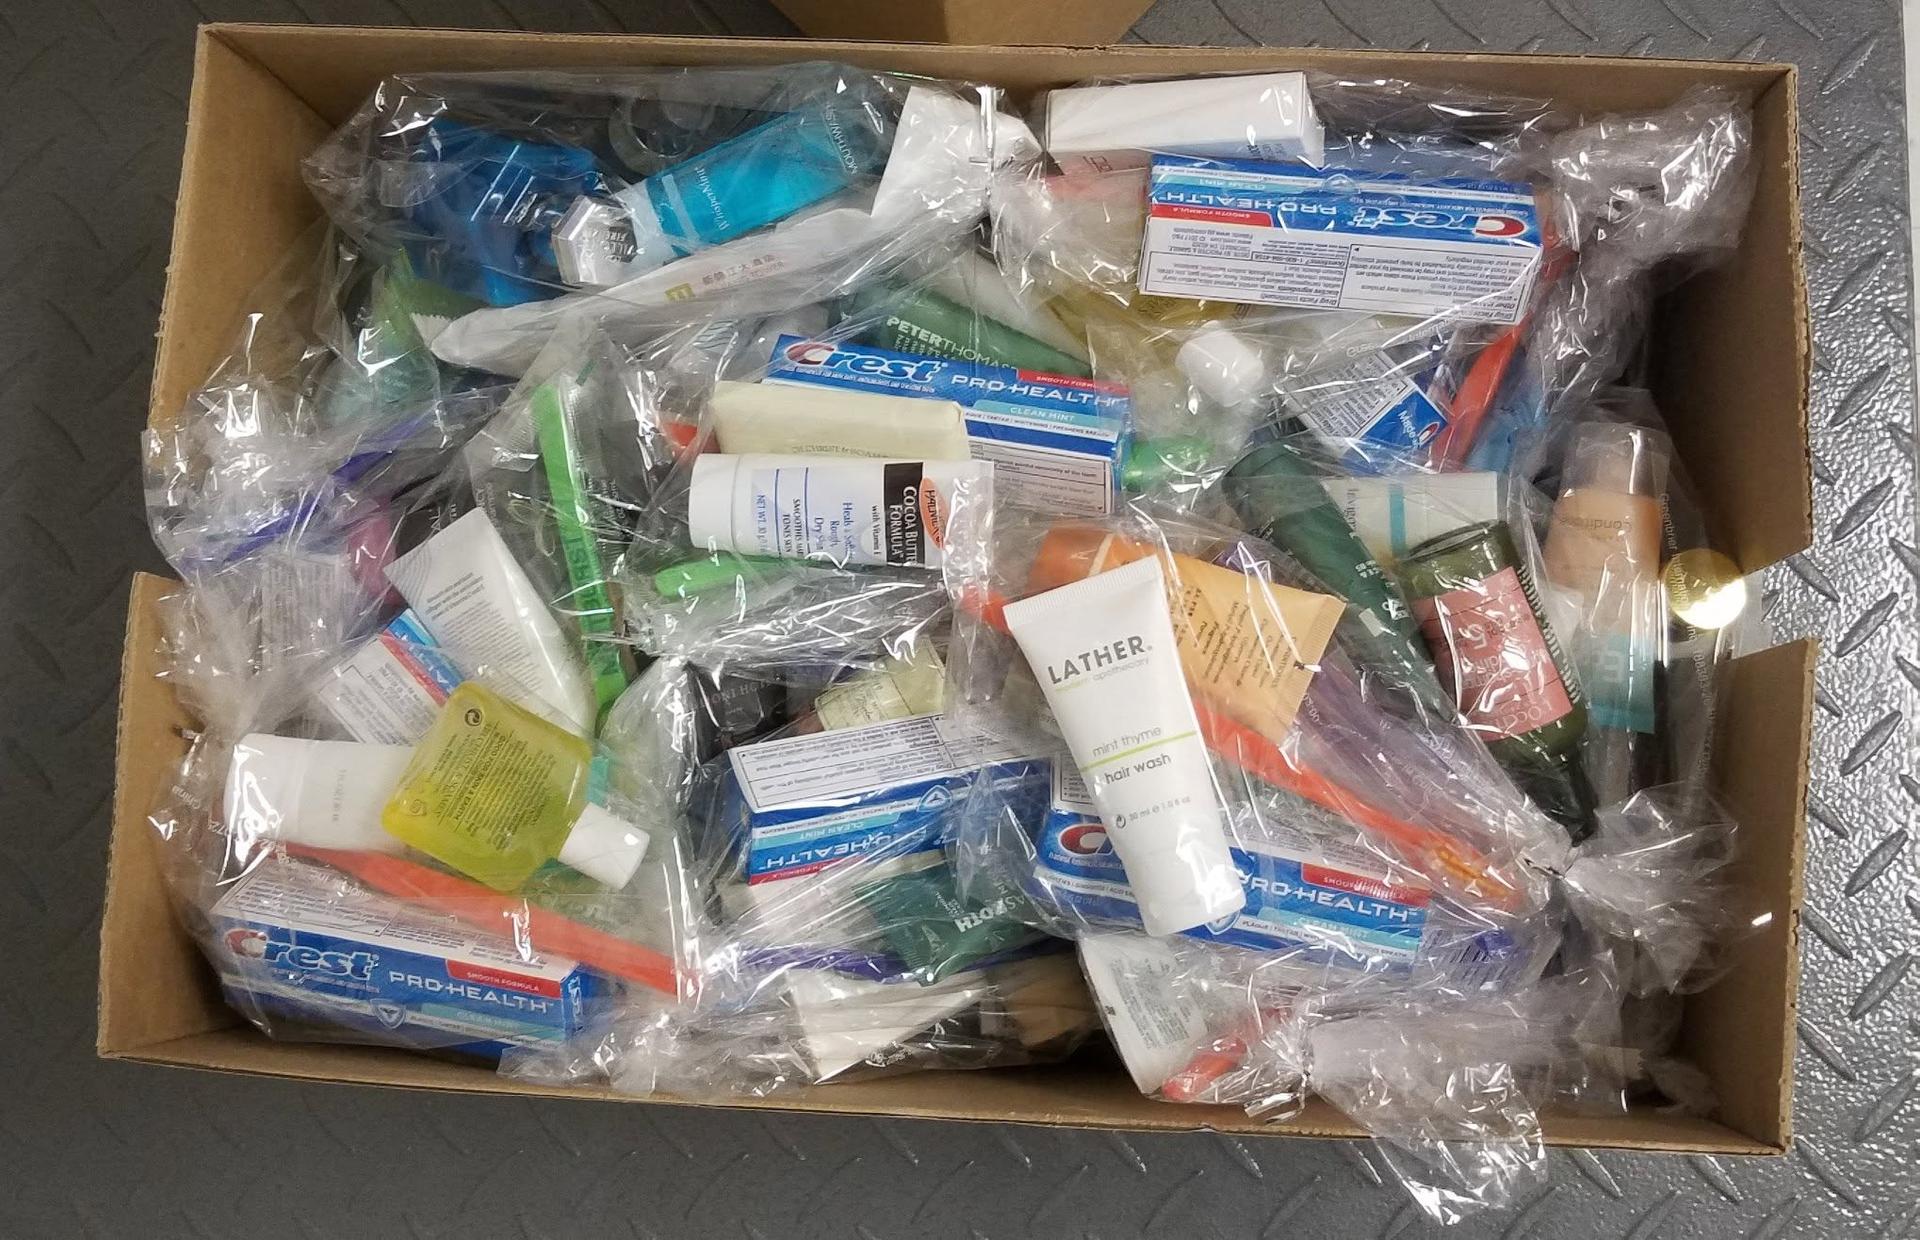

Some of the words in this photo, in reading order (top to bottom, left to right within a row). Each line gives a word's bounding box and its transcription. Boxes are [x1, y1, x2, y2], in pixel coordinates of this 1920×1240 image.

[1351, 204, 1527, 239] Crest
[785, 340, 942, 383] Crest
[1009, 406, 1046, 419] CLEAN
[1047, 412, 1074, 423] MINT
[810, 516, 824, 533] Dry
[870, 505, 879, 522] with
[903, 486, 917, 529] COCOA
[871, 523, 881, 549] Vitamin
[889, 504, 903, 555] FORMULA
[904, 531, 918, 565] BUTTE
[1047, 634, 1145, 686] LATHER
[1091, 735, 1119, 758] mint
[1121, 725, 1163, 753] thyme
[1104, 763, 1132, 786] hair
[1133, 752, 1172, 776] wash
[798, 828, 826, 840] MINT
[827, 820, 864, 833] CLEAN
[222, 926, 375, 981] Crest
[386, 971, 549, 1013] PRO-HEALTH
[465, 971, 500, 984] SMOOTH
[500, 978, 540, 992] FORMULA
